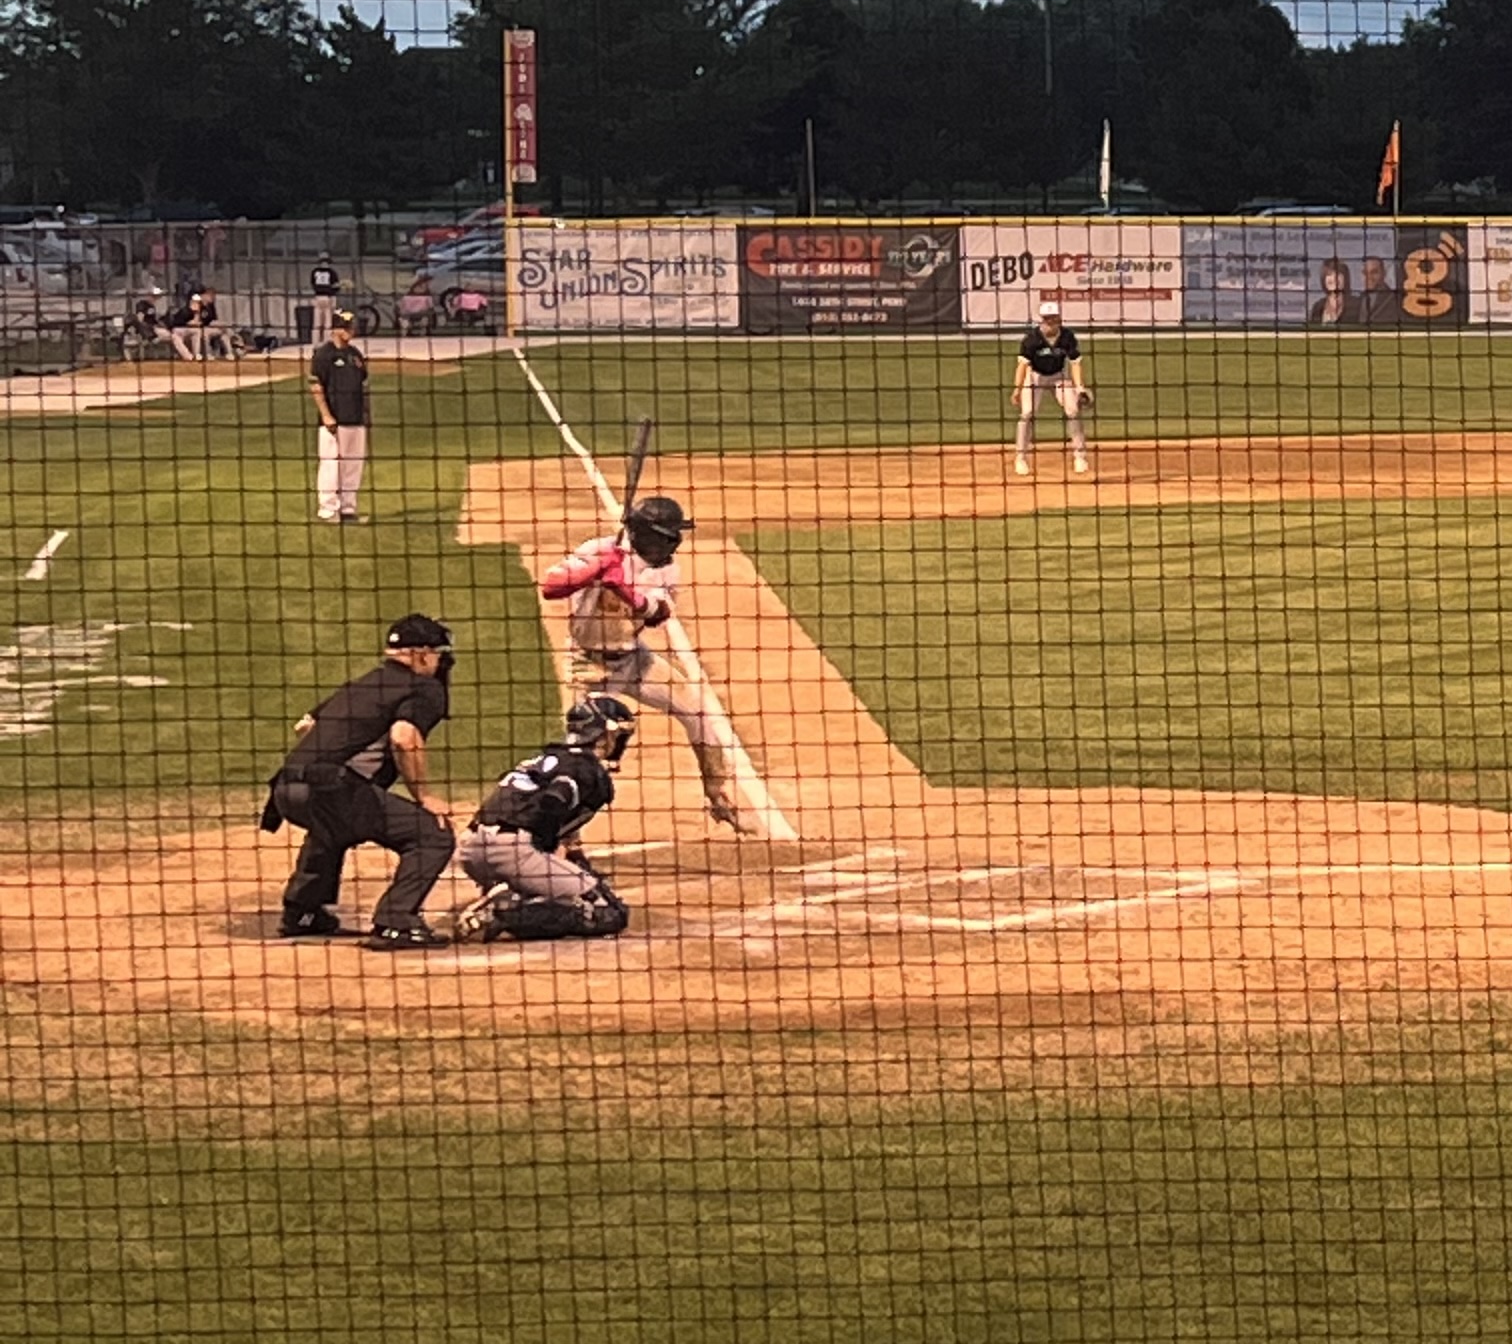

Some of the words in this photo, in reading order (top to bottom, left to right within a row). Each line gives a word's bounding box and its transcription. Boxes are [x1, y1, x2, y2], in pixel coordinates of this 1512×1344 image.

[518, 247, 592, 288] STAR
[746, 233, 884, 277] CASSIDY
[818, 262, 871, 276] SERVICE
[970, 251, 1035, 291] DEBO
[1038, 251, 1091, 273] ACE
[1091, 257, 1174, 273] Hardware
[540, 270, 619, 310] UNION
